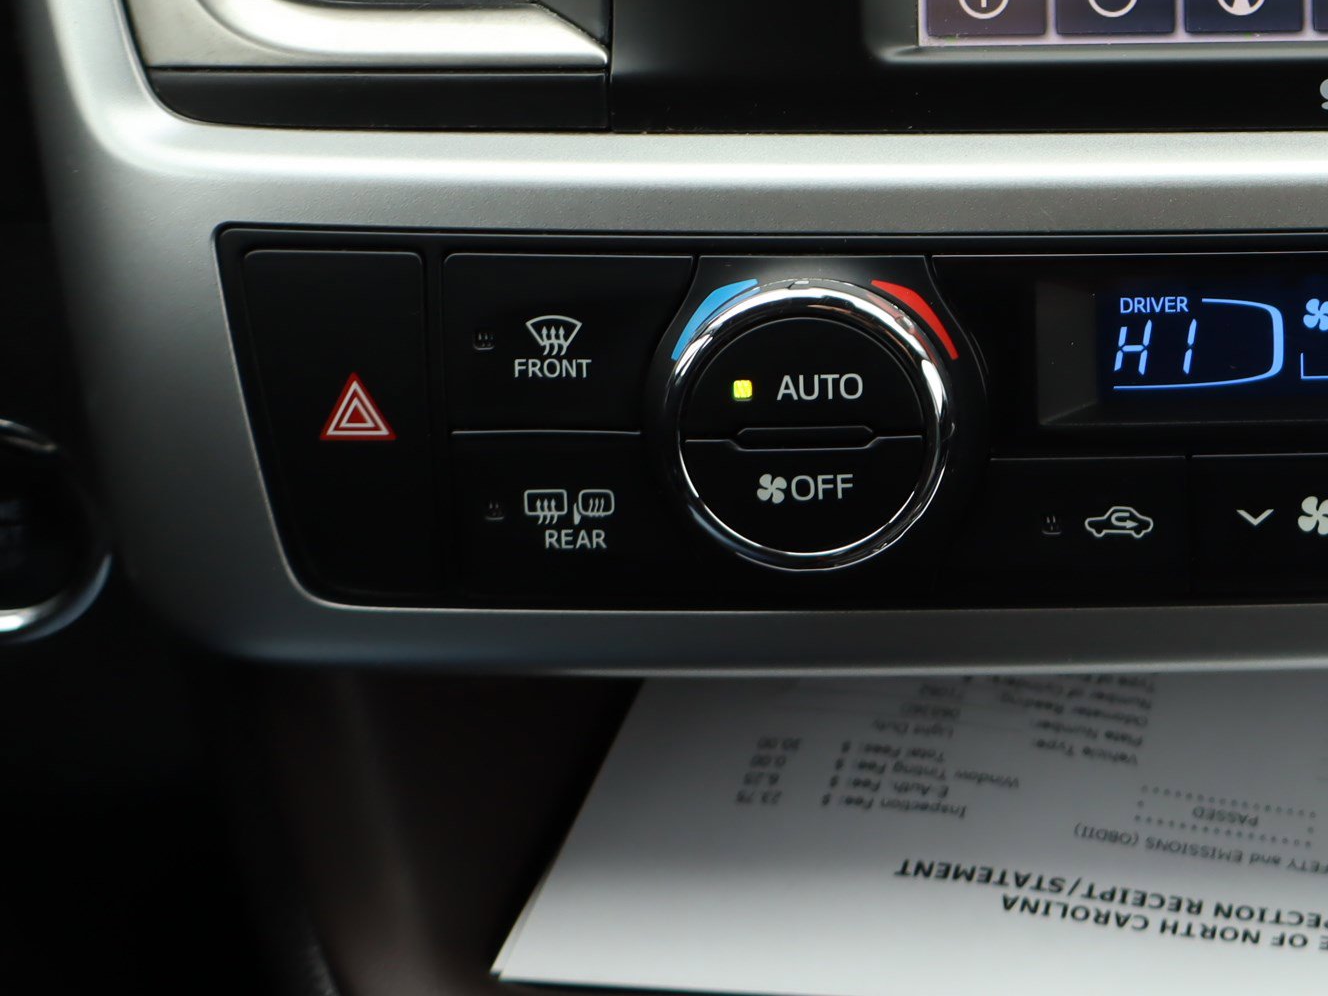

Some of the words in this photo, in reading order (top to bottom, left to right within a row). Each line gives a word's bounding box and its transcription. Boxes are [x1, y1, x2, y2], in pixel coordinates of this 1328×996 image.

[1119, 296, 1189, 314] DRIVER
[513, 358, 592, 379] FRONT
[776, 373, 864, 401] AUTO
[791, 474, 854, 501] OFF
[544, 529, 608, 549] REAR
[1190, 805, 1259, 830] PASSED
[1143, 835, 1243, 866] EMISSIONS
[1248, 851, 1282, 868] and
[893, 858, 1204, 919] RECEIPT/STATEMENT
[1000, 893, 1150, 933] CAROLINA
[1158, 918, 1261, 946] NORTH
[1269, 931, 1309, 950] OF
